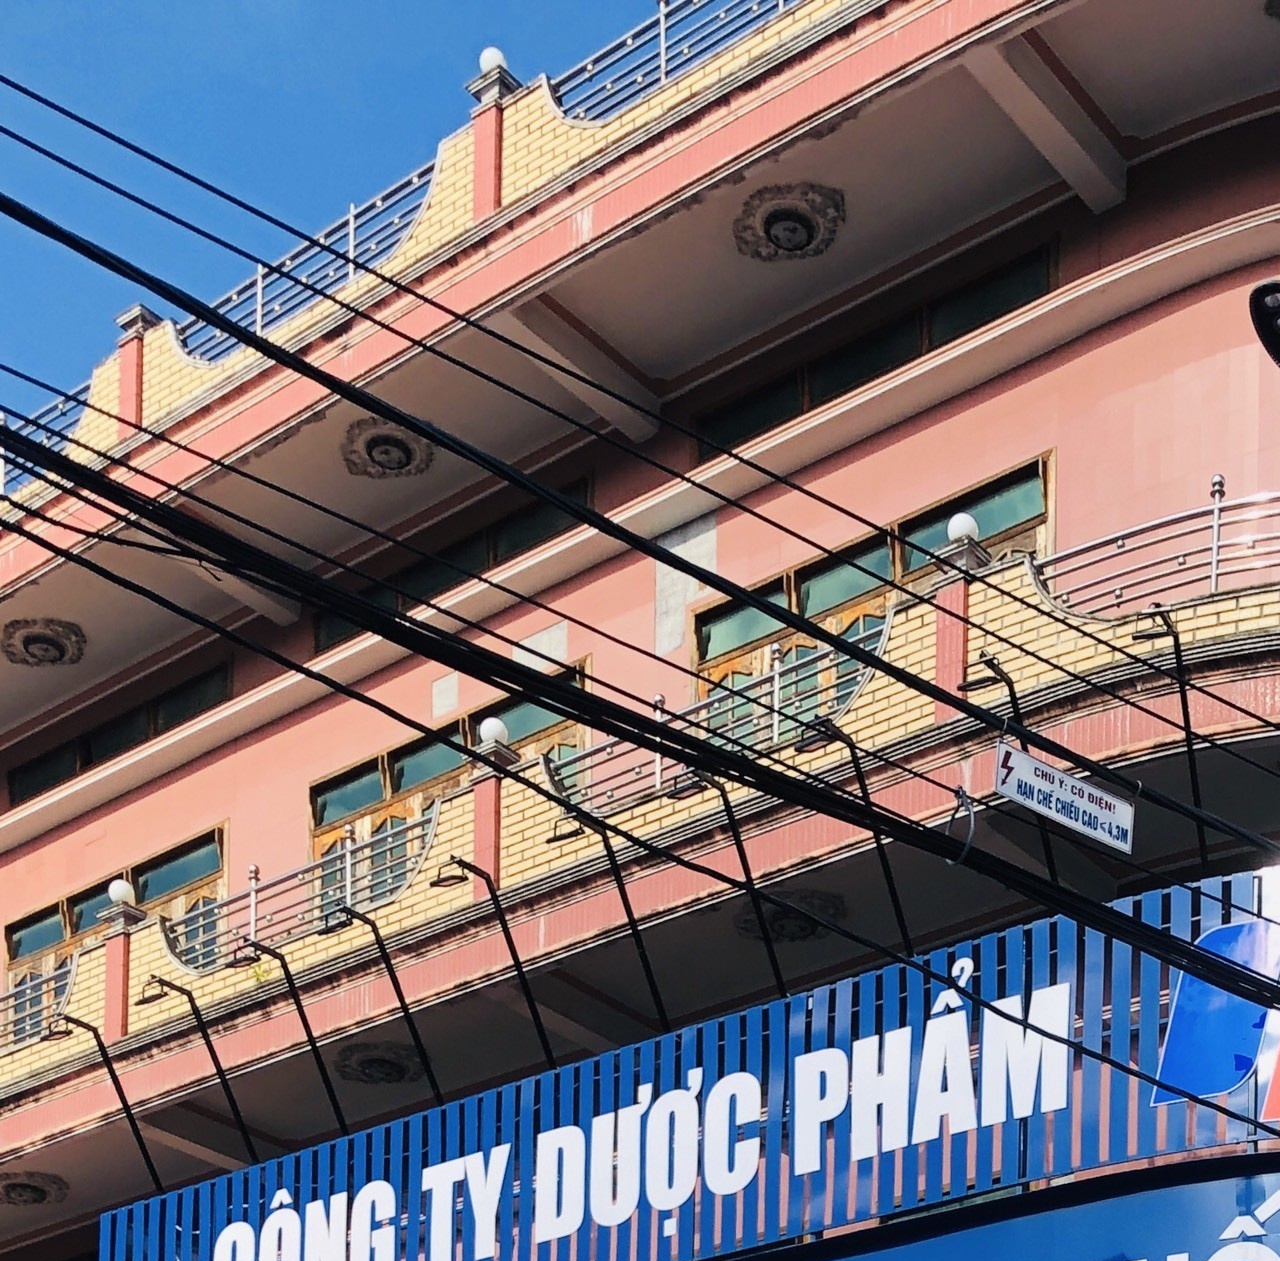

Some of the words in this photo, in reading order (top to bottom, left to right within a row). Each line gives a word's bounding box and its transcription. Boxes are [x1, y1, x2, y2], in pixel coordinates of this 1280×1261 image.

[1017, 779, 1035, 801] HẠN
[1037, 788, 1055, 811] CHẾ
[1082, 810, 1099, 831] CAO
[1034, 767, 1055, 785] CHÚ
[1070, 785, 1085, 799] CÓ
[1088, 793, 1116, 814] ĐIỆN!
[535, 1066, 761, 1244] DƯỢC
[794, 957, 1072, 1177] PHẨM
